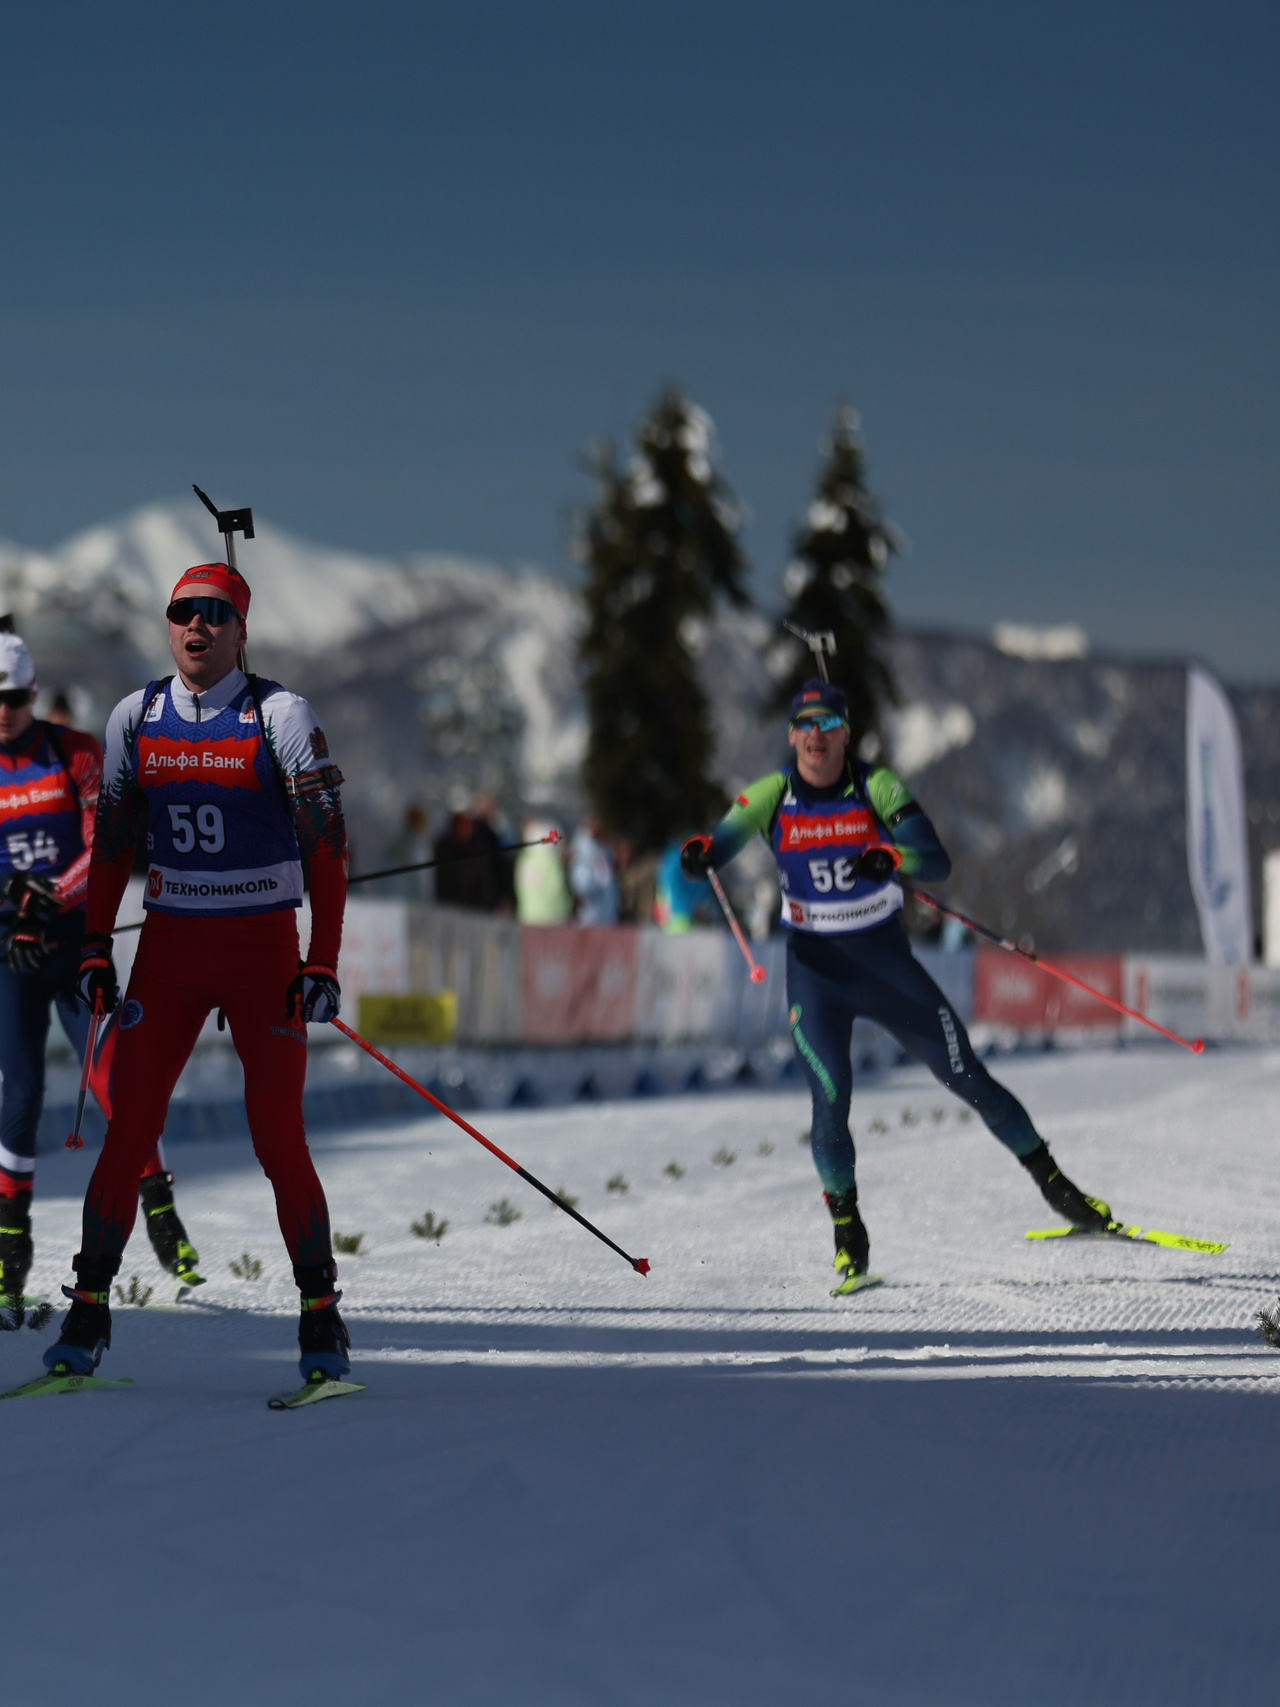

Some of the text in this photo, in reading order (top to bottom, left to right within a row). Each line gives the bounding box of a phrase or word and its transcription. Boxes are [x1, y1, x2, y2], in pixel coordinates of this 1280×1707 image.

[145, 751, 246, 771] Альфа Банк
[30, 788, 67, 804] Банк
[167, 804, 225, 854] 59
[788, 820, 869, 841] Альфа Банк
[6, 830, 59, 871] 54
[808, 857, 857, 893] 58
[165, 877, 278, 897] ТЕХНОНИКОЛЬ
[806, 898, 889, 922] ТЕХНОНИКОЛЬ
